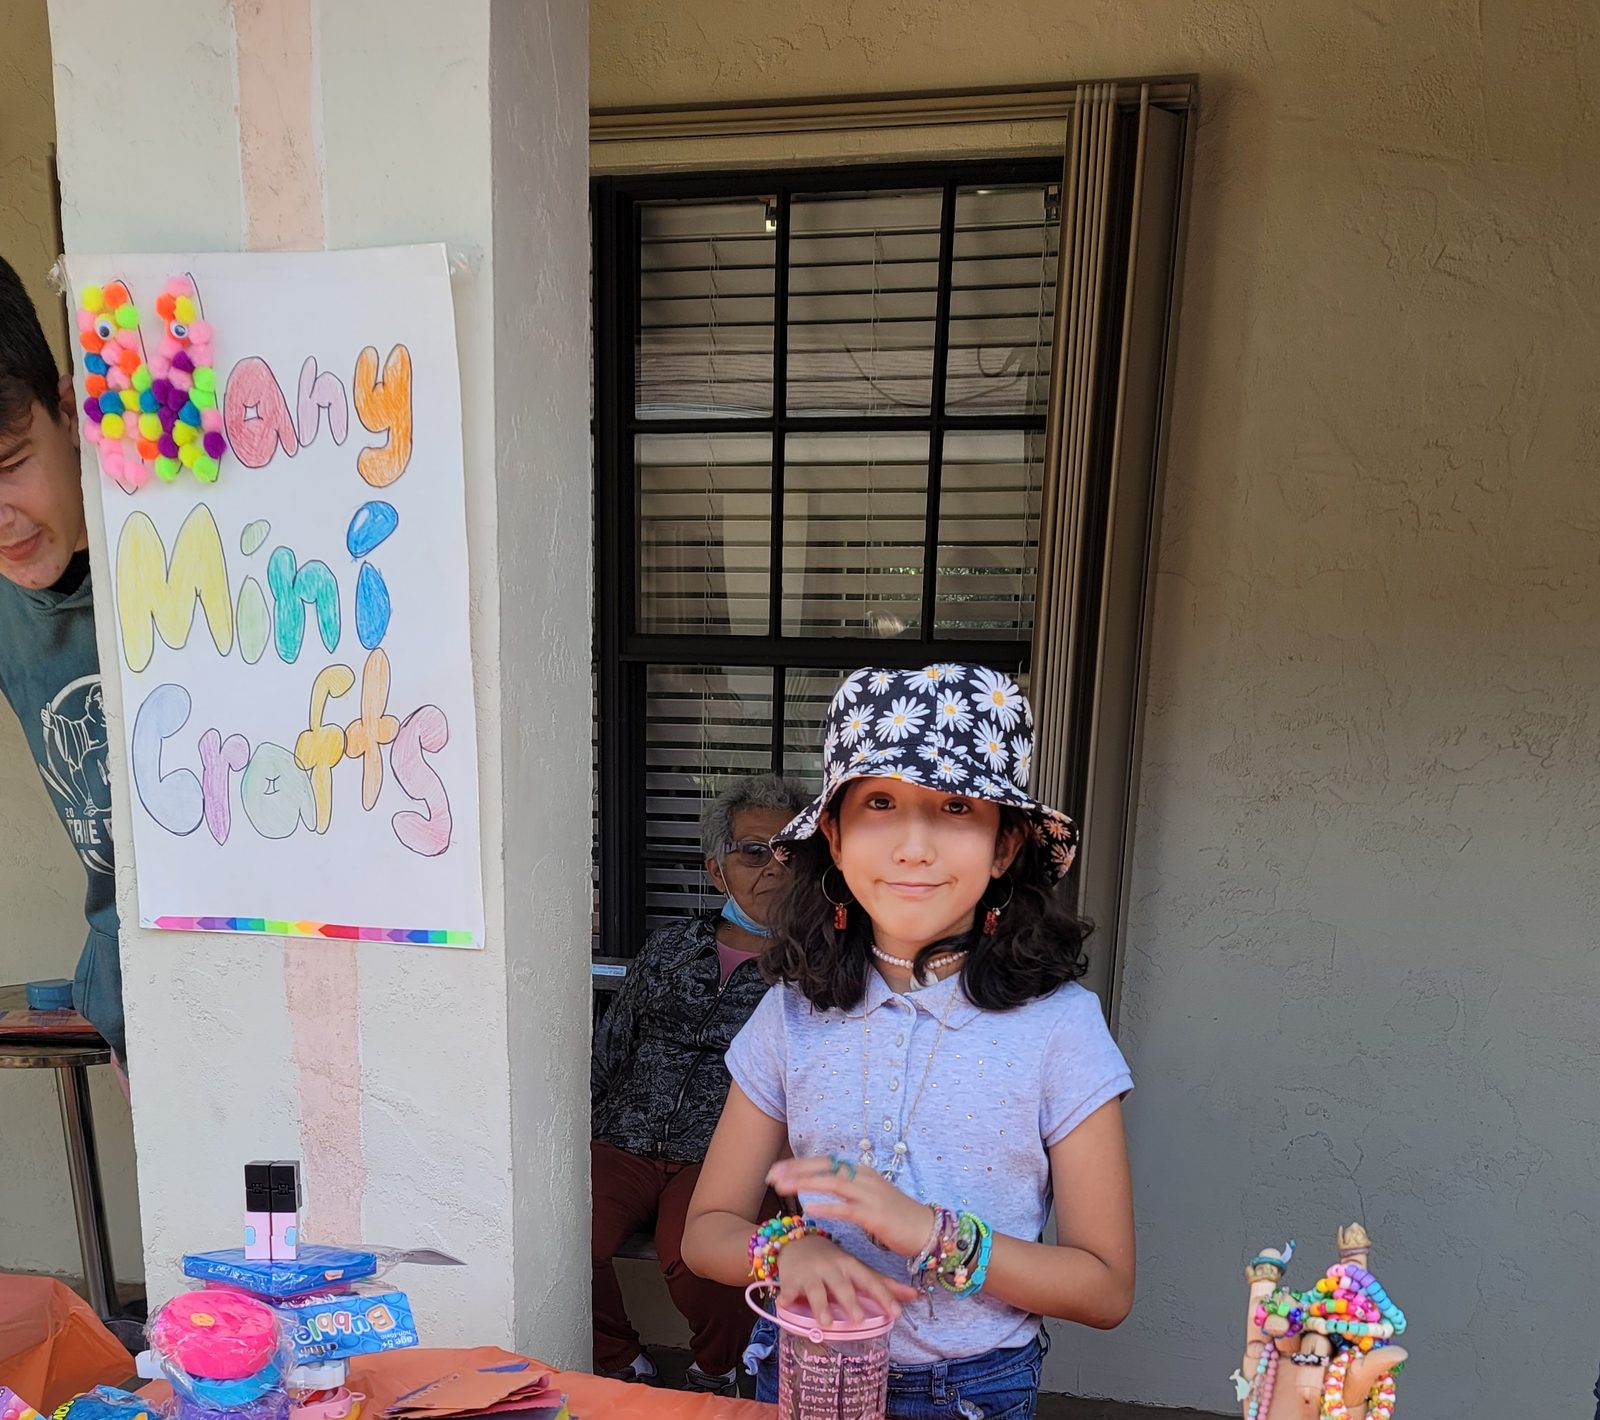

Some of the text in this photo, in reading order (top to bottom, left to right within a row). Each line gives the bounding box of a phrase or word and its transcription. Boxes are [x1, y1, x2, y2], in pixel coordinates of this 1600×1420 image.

[116, 501, 398, 673] Mini
[132, 647, 452, 857] Crafts
[293, 1303, 397, 1345] Bubble
[804, 1350, 829, 1364] love
[802, 1370, 826, 1384] love
[801, 1389, 826, 1404] love
